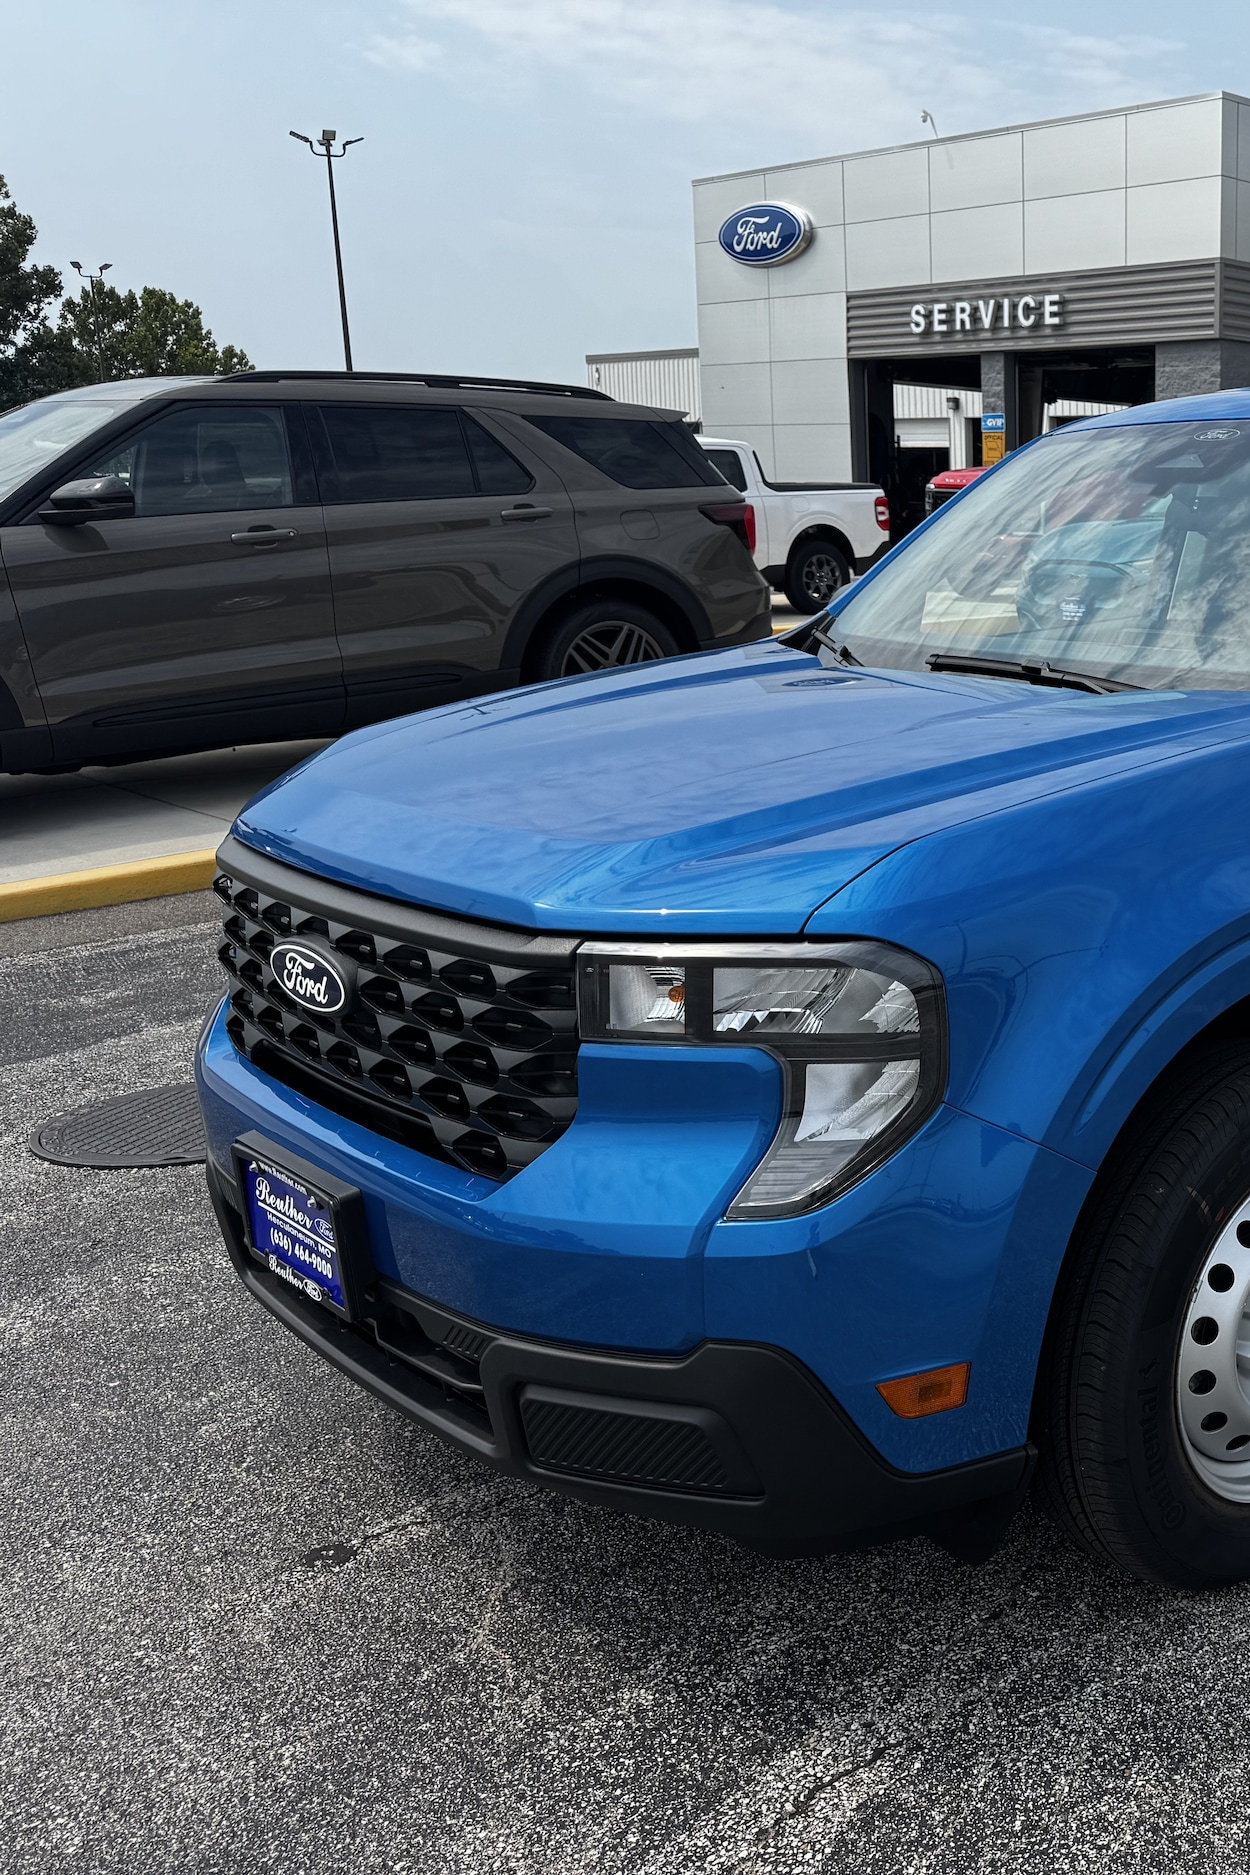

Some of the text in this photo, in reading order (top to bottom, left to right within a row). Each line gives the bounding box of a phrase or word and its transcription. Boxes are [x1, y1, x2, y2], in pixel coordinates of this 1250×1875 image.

[733, 216, 783, 252] Ford
[909, 294, 1062, 334] SERVICE
[1199, 430, 1234, 440] Ford
[283, 952, 329, 1005] Ford
[256, 1177, 313, 1229] Reuther
[267, 1211, 332, 1259] Herculaneum, MO
[270, 1227, 333, 1280] (636) 464-9000
[268, 1254, 304, 1290] Reuther
[1135, 1383, 1188, 1532] Continental
